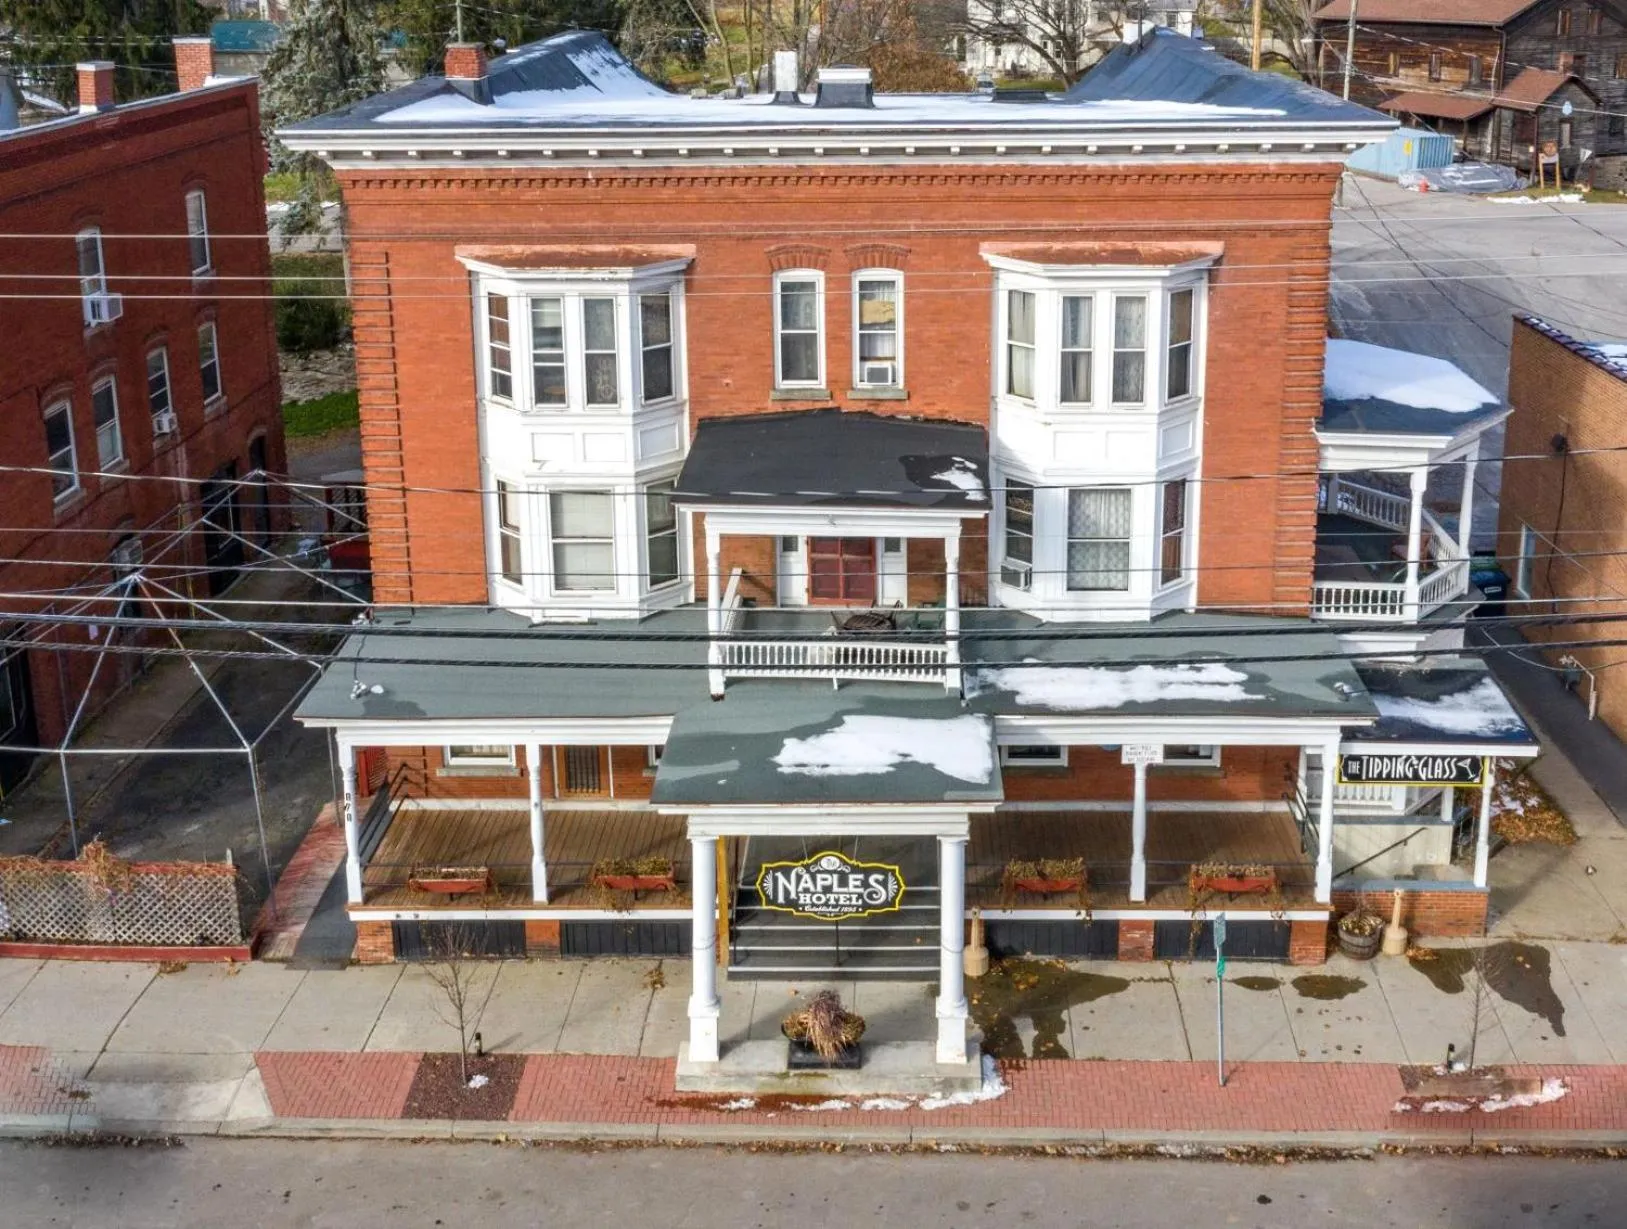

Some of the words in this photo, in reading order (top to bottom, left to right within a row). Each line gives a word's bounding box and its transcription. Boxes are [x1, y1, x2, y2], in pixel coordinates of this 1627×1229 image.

[1348, 760, 1360, 774] THE
[1361, 756, 1414, 780] TIPPING
[1418, 756, 1457, 780] GLASS
[775, 866, 887, 905] NAPLES
[798, 893, 862, 905] HOTEL
